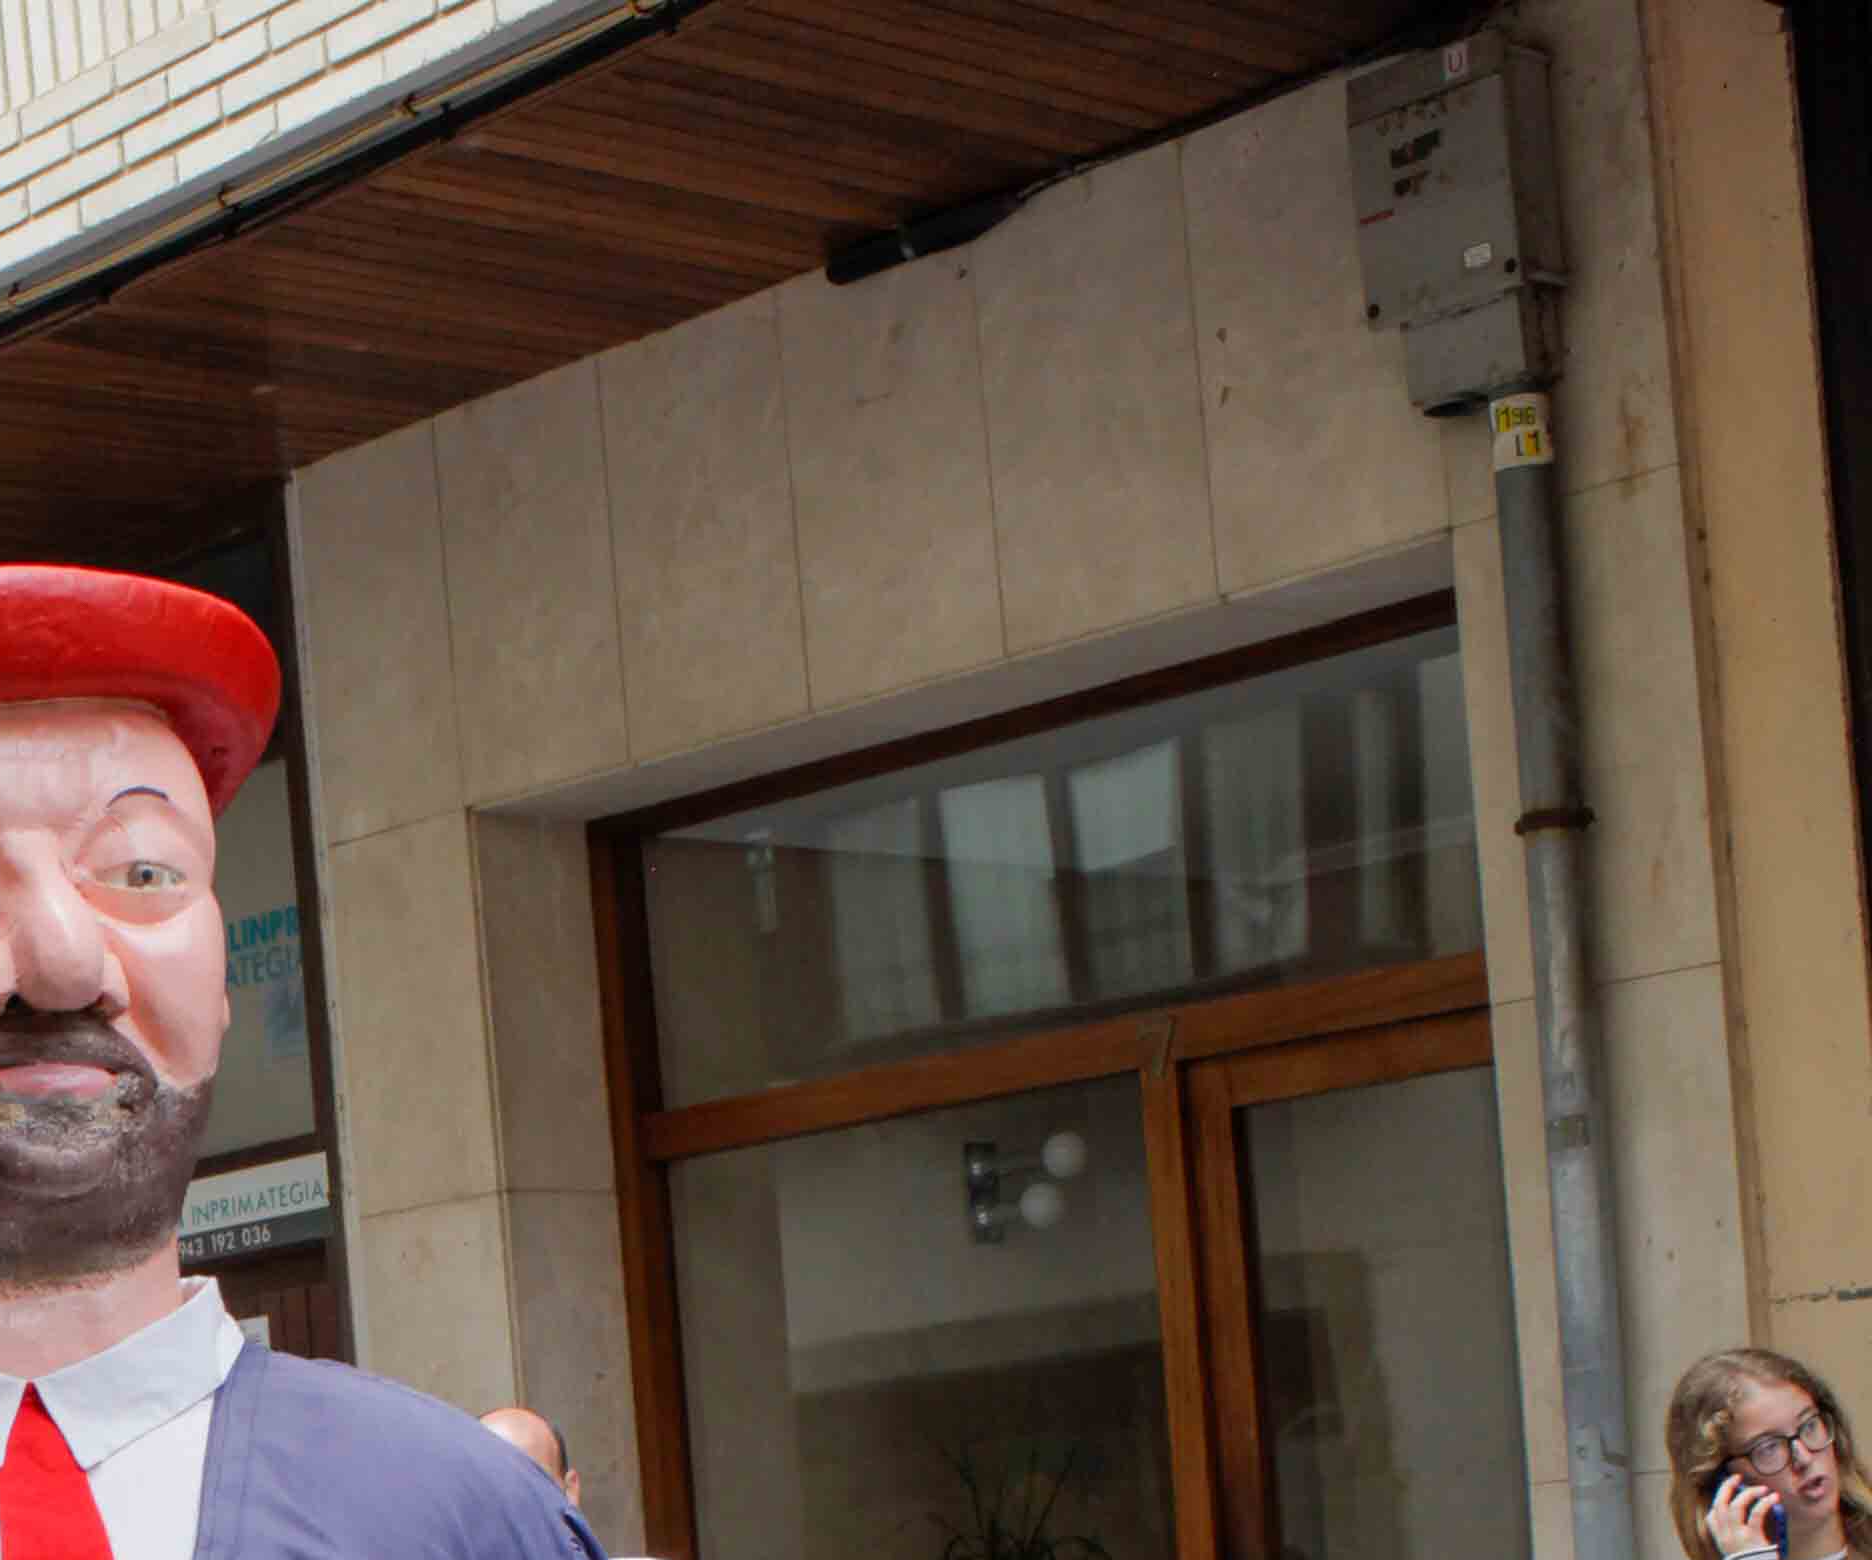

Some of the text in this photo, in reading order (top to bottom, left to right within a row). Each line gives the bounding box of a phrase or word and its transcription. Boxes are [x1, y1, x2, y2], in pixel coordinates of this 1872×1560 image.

[191, 1178, 324, 1226] INPRIMATEGIA
[210, 1230, 235, 1253] 192
[241, 1223, 271, 1248] 036
